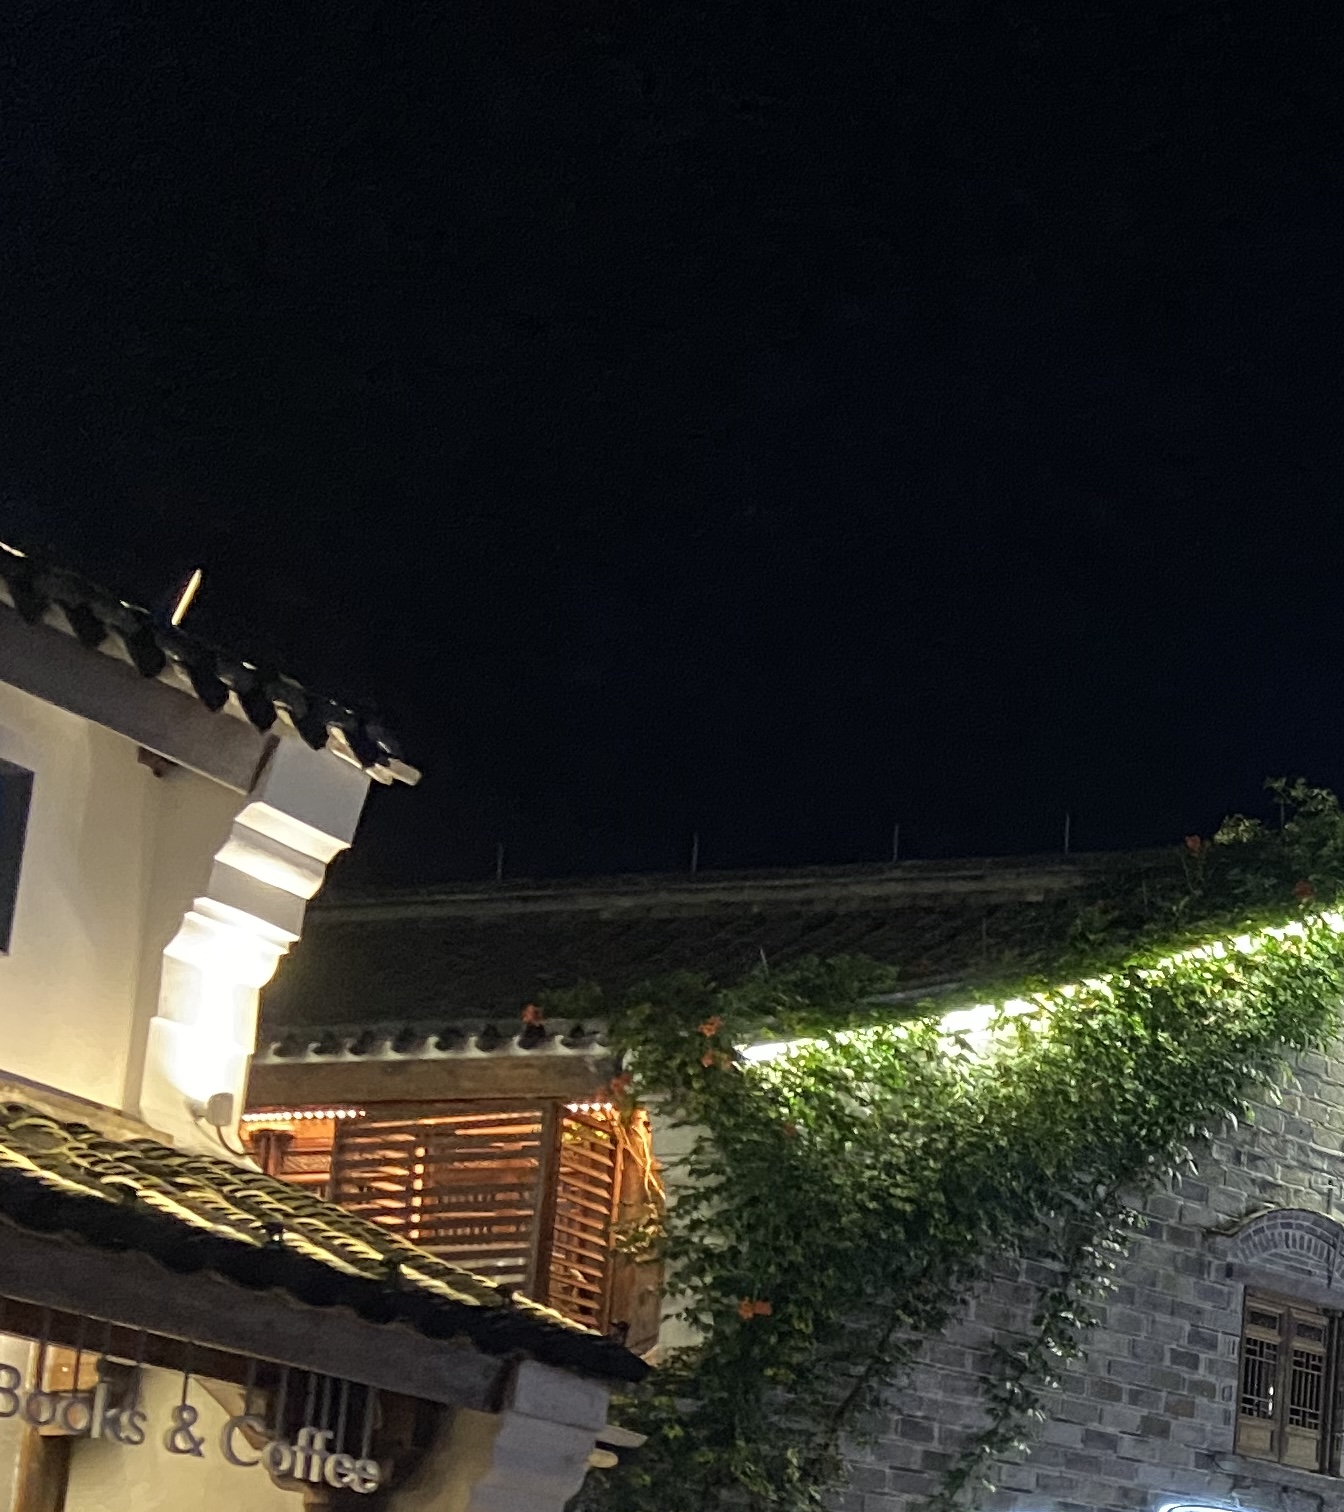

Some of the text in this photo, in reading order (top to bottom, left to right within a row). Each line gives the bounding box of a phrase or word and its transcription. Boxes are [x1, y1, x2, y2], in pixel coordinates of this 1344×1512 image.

[0, 1363, 382, 1494] Books & Coffee
